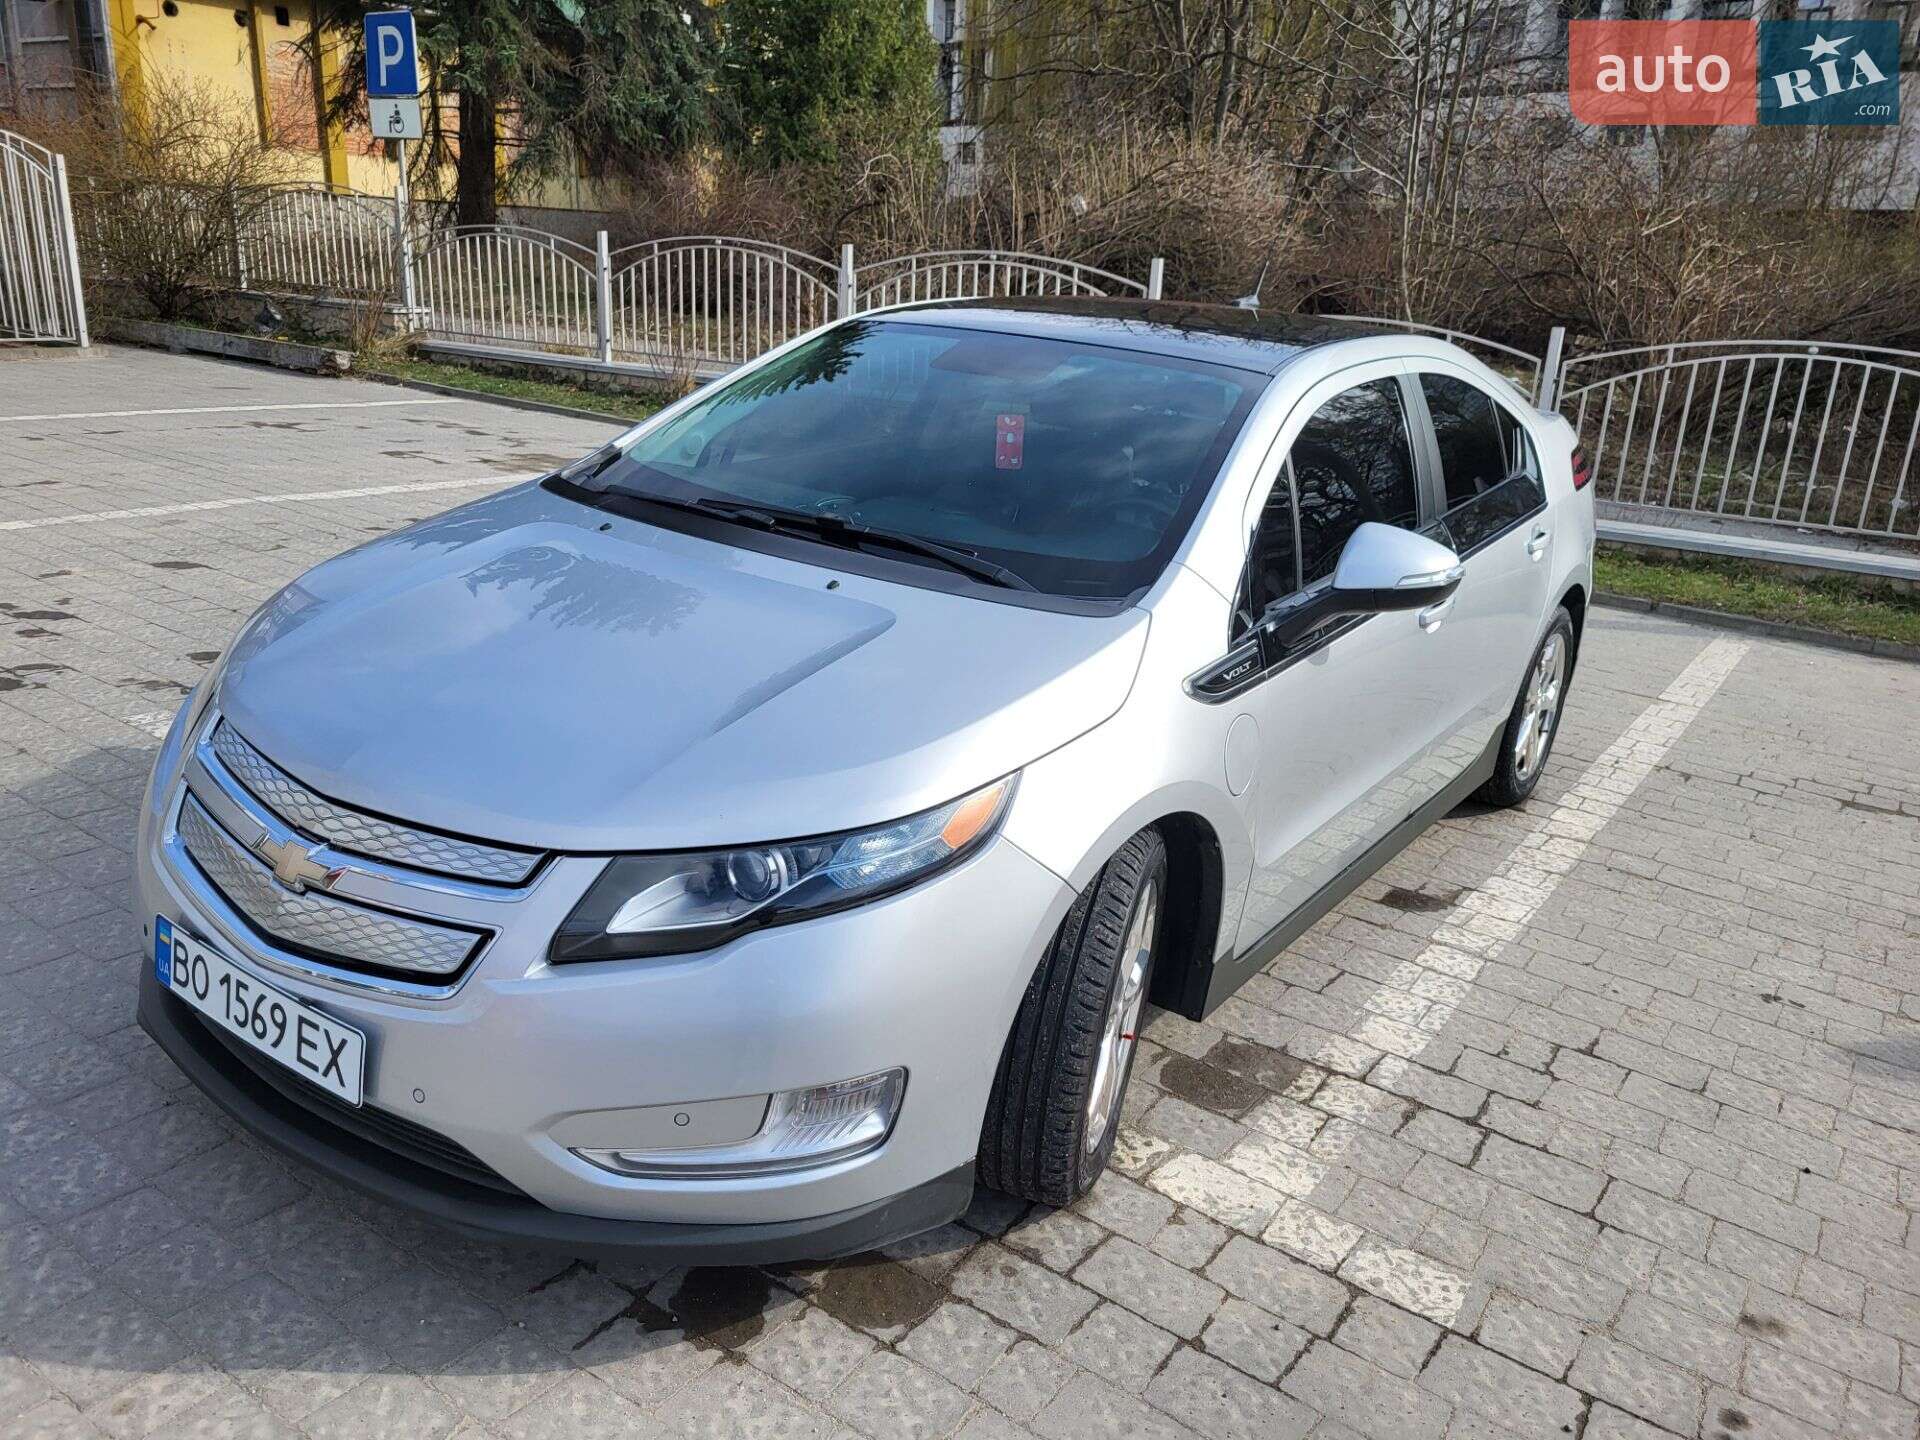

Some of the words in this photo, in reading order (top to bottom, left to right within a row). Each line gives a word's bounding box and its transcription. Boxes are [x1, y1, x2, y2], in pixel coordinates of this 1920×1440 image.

[377, 25, 404, 87] P
[1223, 660, 1252, 680] VOLT
[157, 958, 170, 977] UA
[173, 937, 209, 1001] BO
[219, 972, 288, 1049] 1569
[296, 1014, 349, 1088] EX
